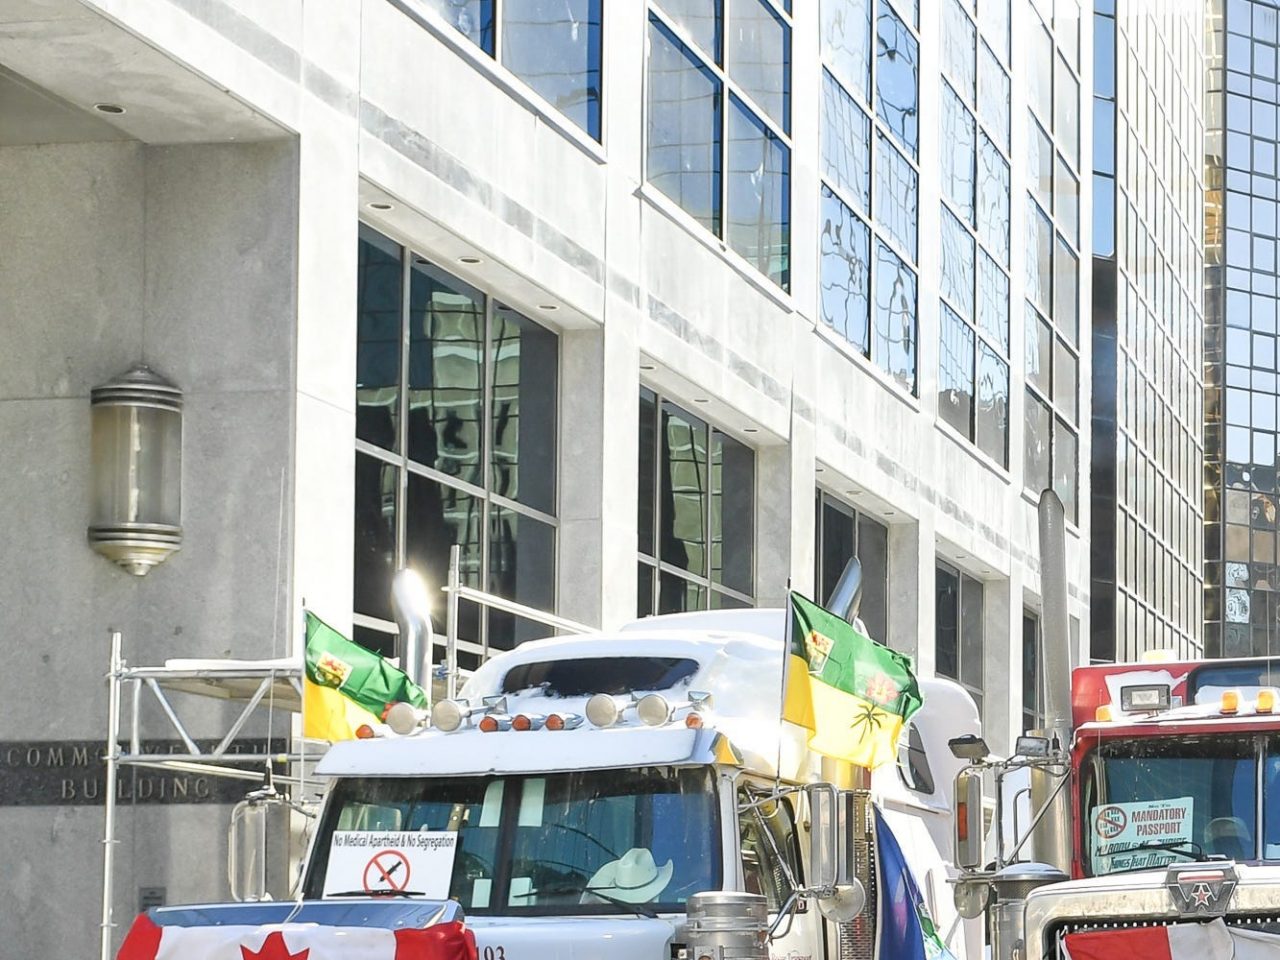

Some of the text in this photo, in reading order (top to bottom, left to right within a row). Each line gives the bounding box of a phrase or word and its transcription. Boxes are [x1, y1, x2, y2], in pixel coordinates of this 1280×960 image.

[61, 776, 209, 800] BULDING
[1131, 807, 1186, 823] MANDATORY
[1136, 821, 1181, 836] PASSPORT
[334, 834, 342, 847] No
[344, 834, 368, 847] Medical
[368, 834, 400, 848] Apartheid
[407, 834, 417, 847] No
[417, 834, 454, 851] Segregation
